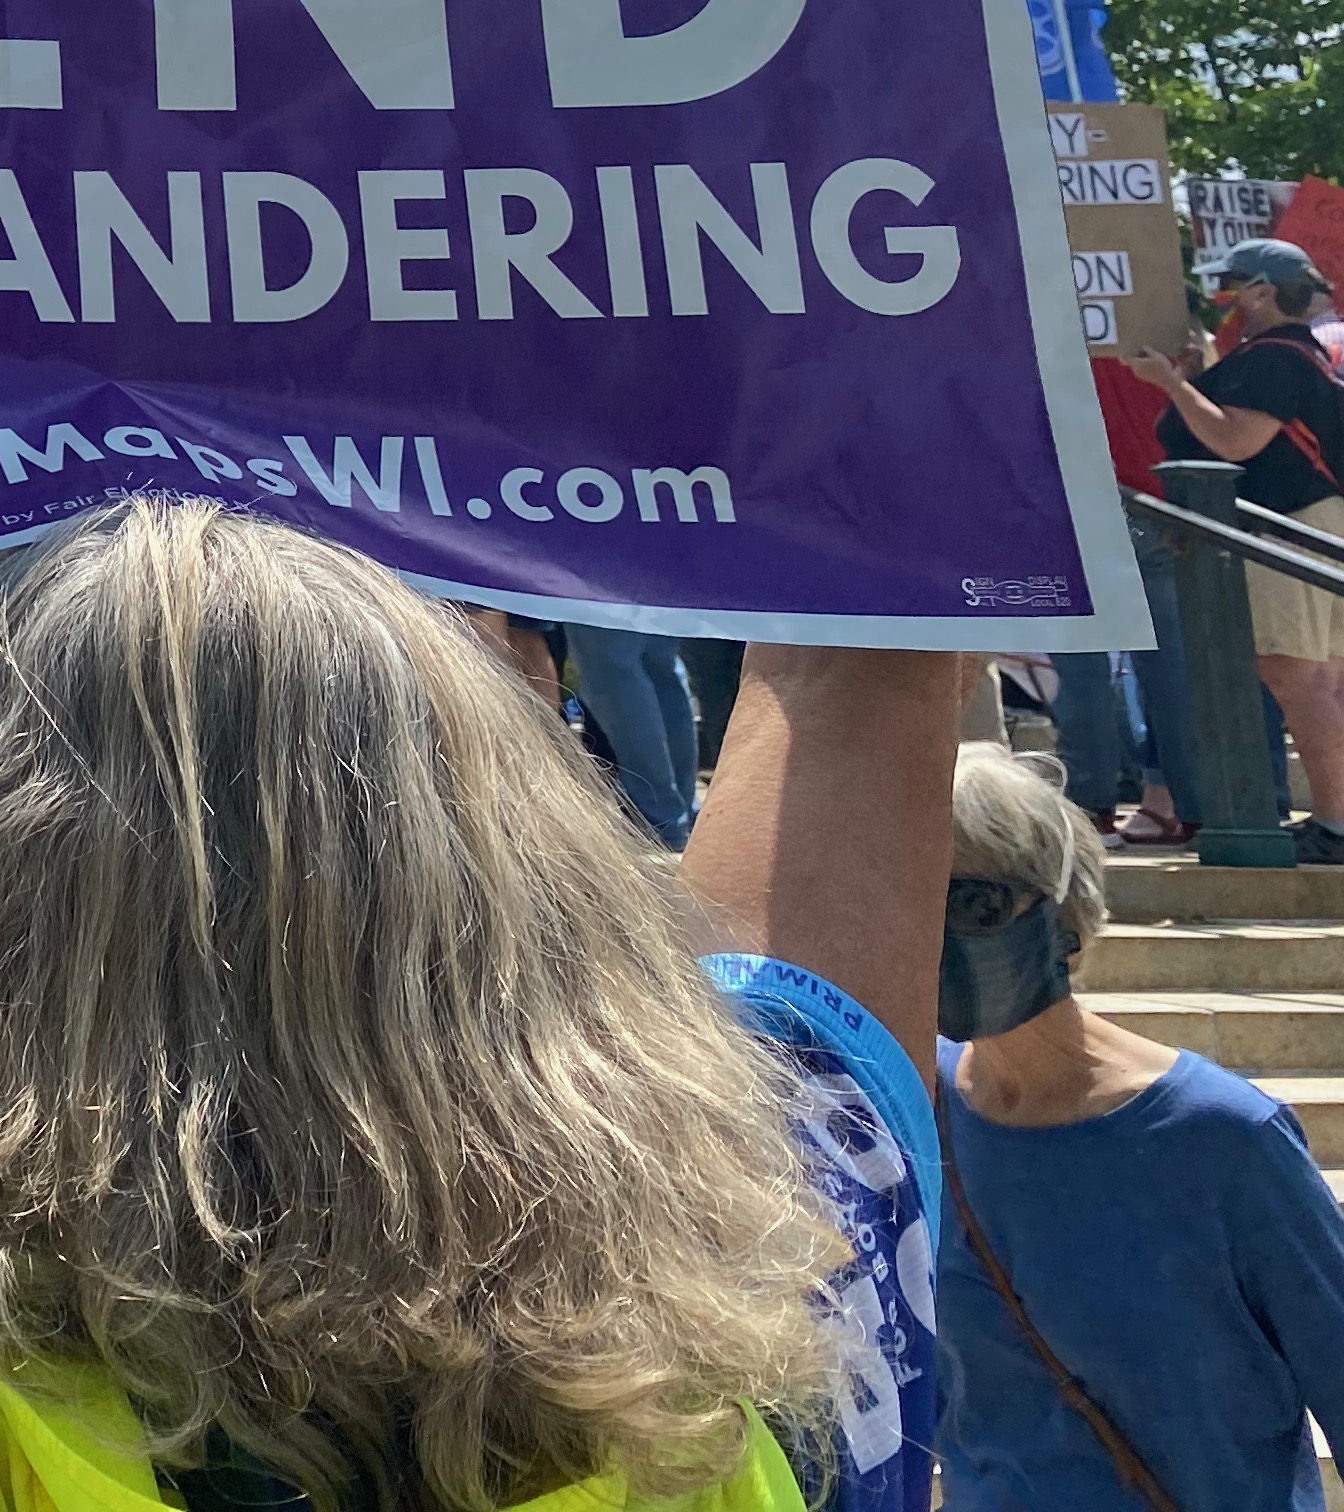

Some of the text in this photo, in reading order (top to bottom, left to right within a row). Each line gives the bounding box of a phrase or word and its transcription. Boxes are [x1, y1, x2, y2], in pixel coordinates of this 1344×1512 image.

[1195, 183, 1270, 217] RAISE
[1, 510, 34, 526] by
[43, 493, 95, 515] Fair
